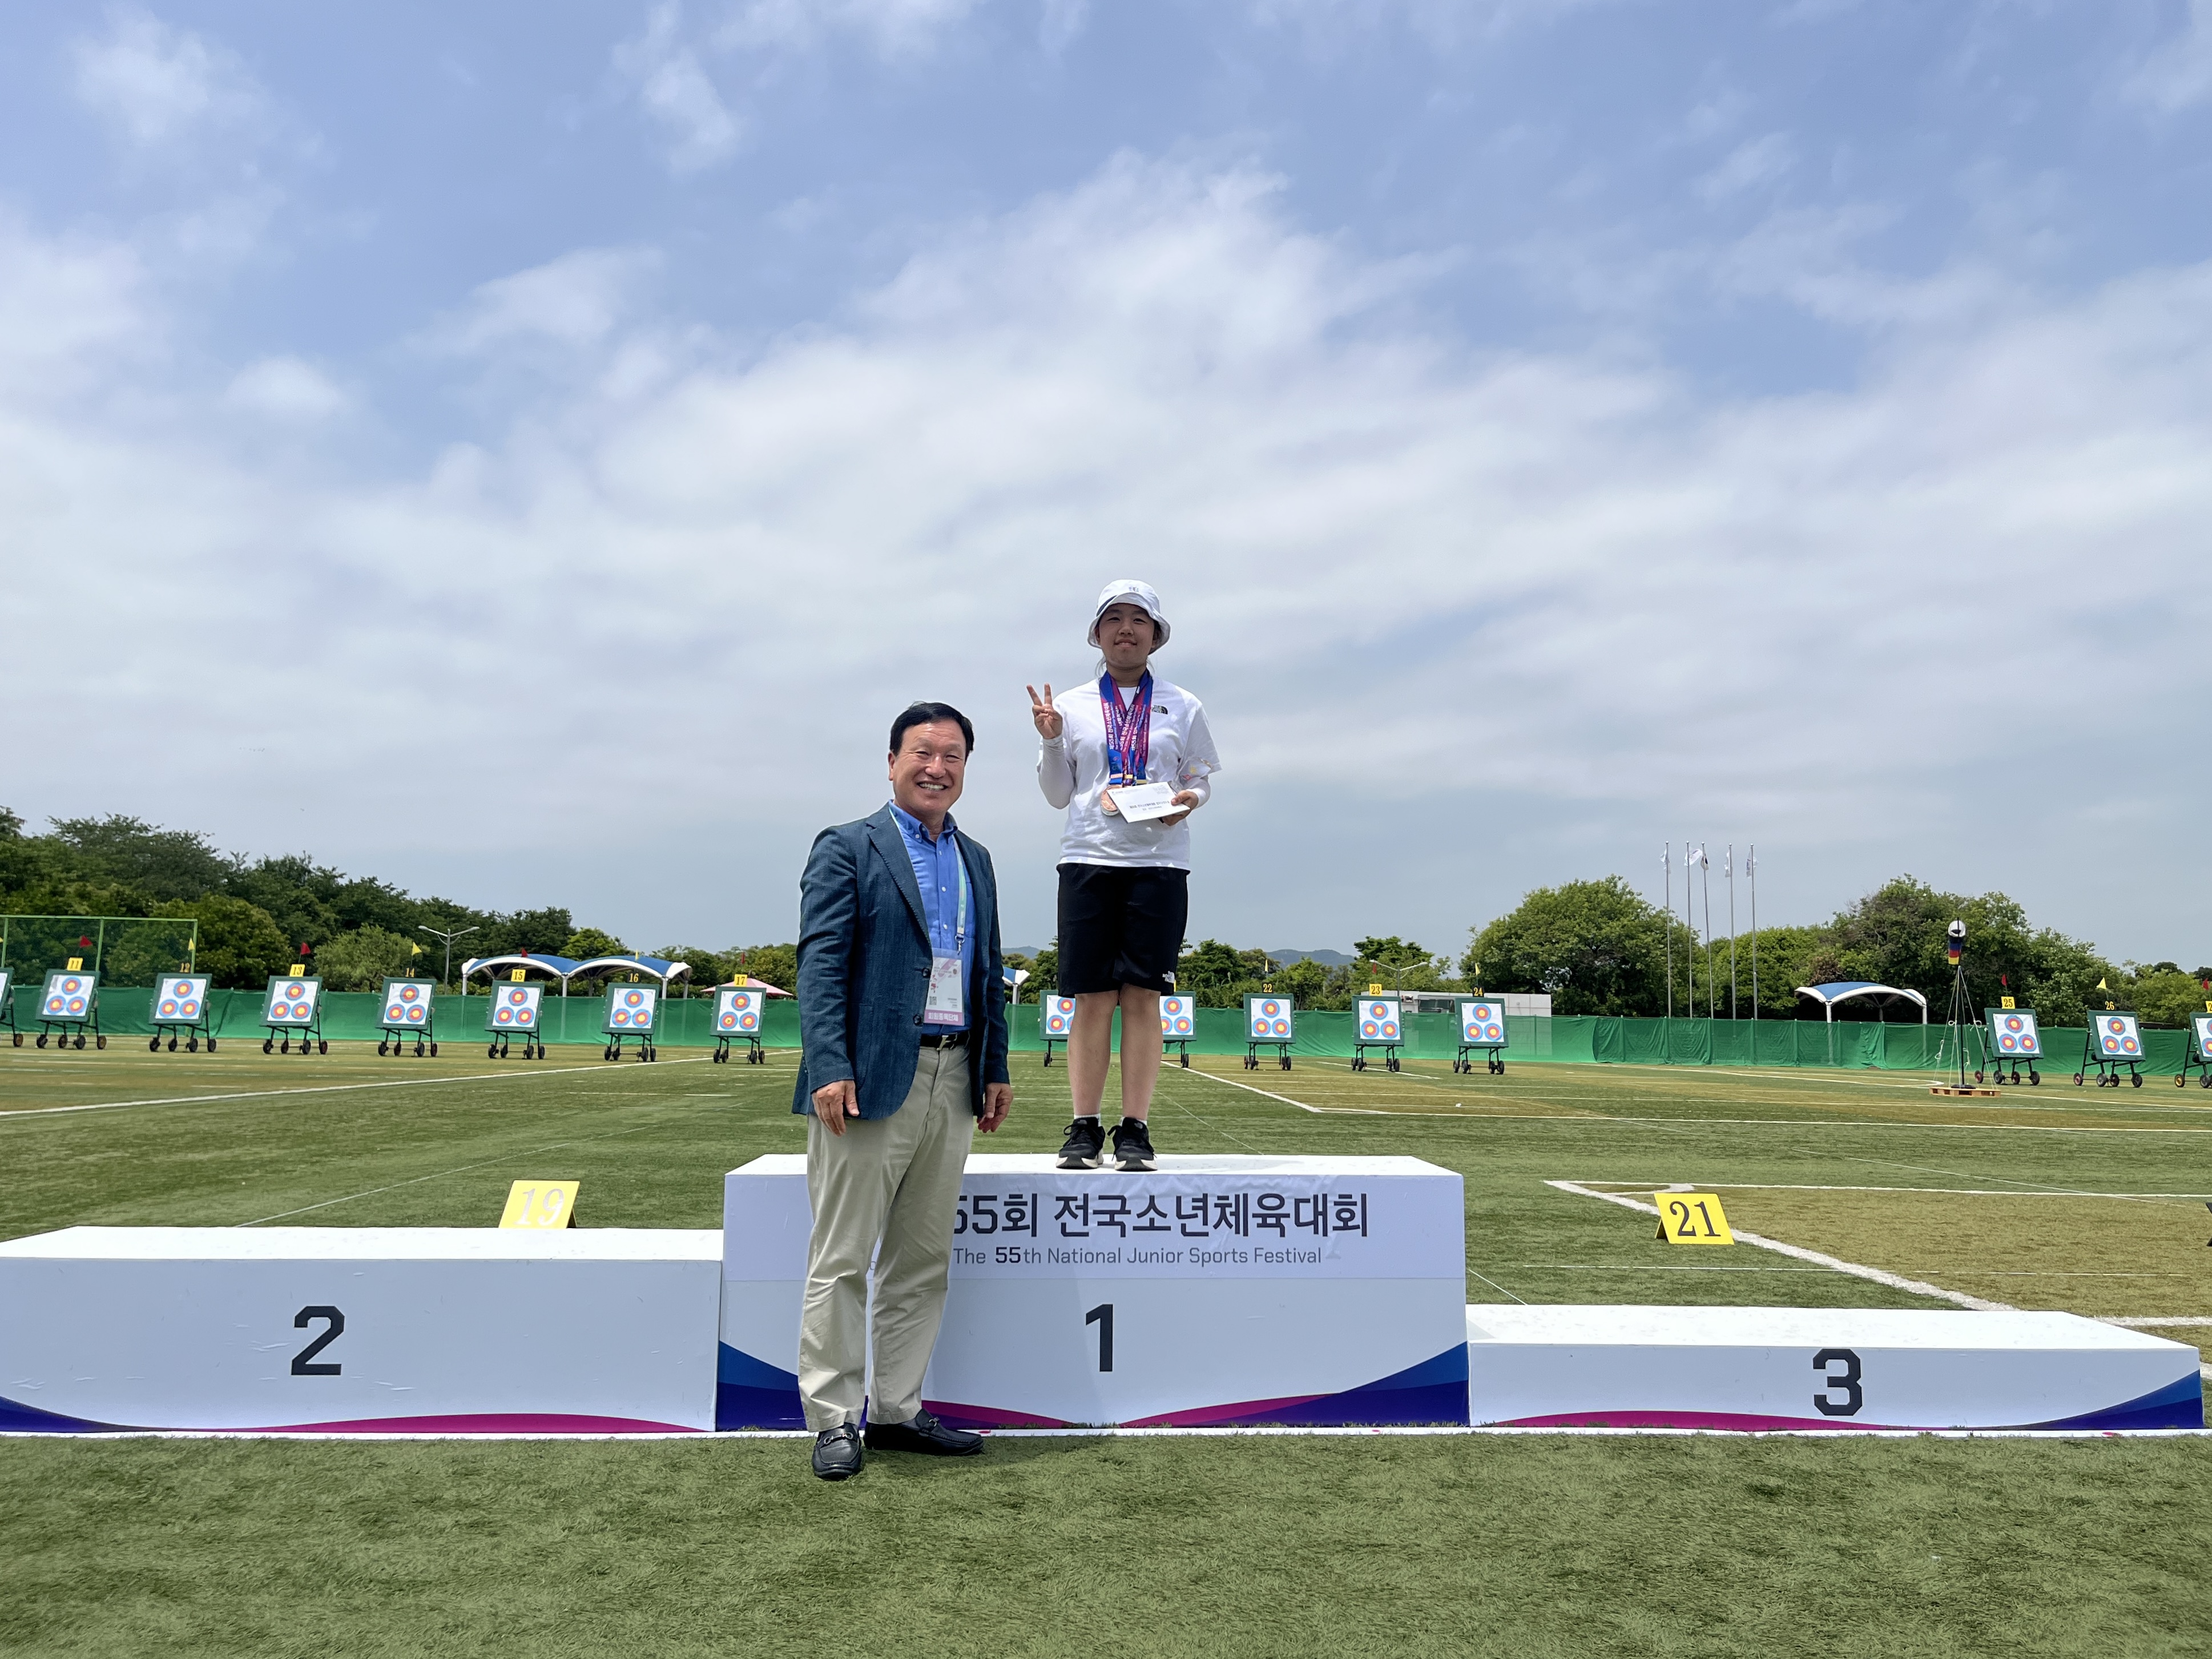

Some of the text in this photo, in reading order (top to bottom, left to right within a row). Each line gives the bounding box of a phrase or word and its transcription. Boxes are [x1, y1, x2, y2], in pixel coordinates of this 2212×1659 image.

[70, 960, 79, 969] 11
[292, 966, 303, 975] 13
[405, 967, 414, 978] 14
[514, 971, 523, 980] 15
[629, 973, 639, 983] 16
[736, 976, 746, 985] 17
[1263, 983, 1272, 993] 22
[1371, 986, 1380, 995] 23
[1473, 987, 1483, 996] 24
[2004, 998, 2013, 1007] 25
[2105, 1000, 2115, 1010] 26
[2208, 1003, 2212, 1011] 2
[928, 1012, 959, 1022] 회원종목단체
[514, 1188, 564, 1225] 19
[1054, 1193, 1367, 1237] 전국소년체육대회
[1670, 1201, 1721, 1237] 21
[953, 1246, 1321, 1268] The 55th National Junior Sports Festival
[291, 1306, 345, 1375] 2
[1085, 1304, 1113, 1372] 1
[1812, 1349, 1863, 1416] 3
